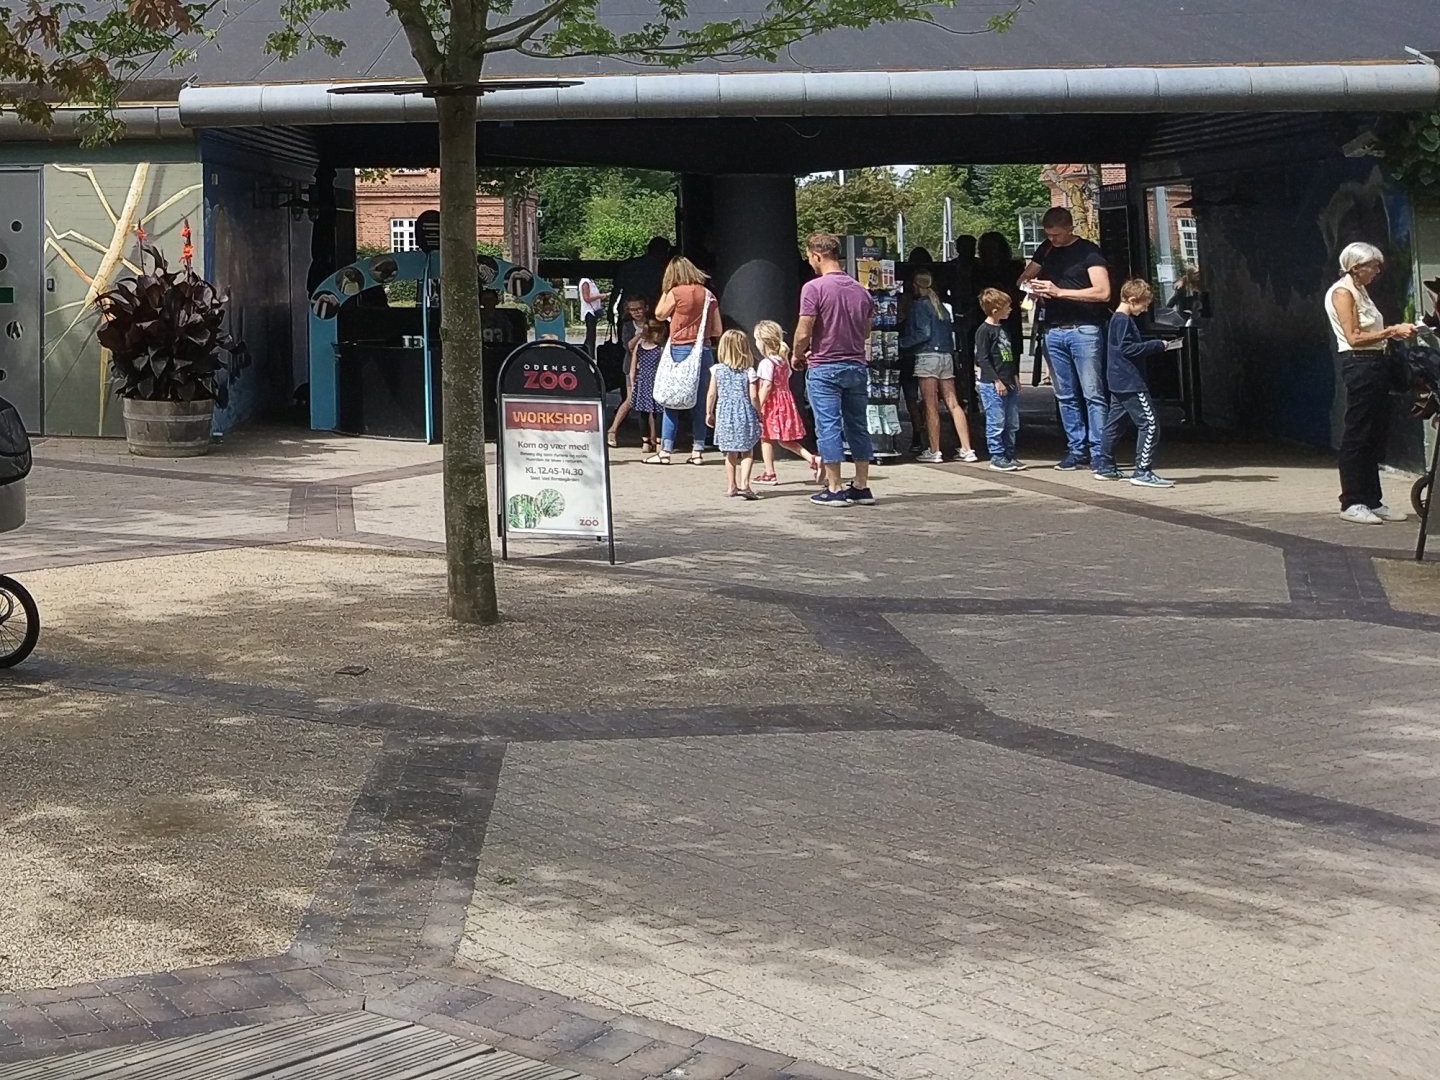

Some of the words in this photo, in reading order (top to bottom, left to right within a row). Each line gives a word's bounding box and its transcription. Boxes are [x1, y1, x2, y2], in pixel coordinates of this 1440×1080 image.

[523, 363, 577, 372] ODENSE
[523, 371, 578, 391] ZOO
[512, 411, 593, 425] WORKSHOP
[517, 440, 537, 449] Kom
[538, 442, 549, 451] og
[568, 443, 590, 451] med!
[579, 518, 600, 527] ZOO
